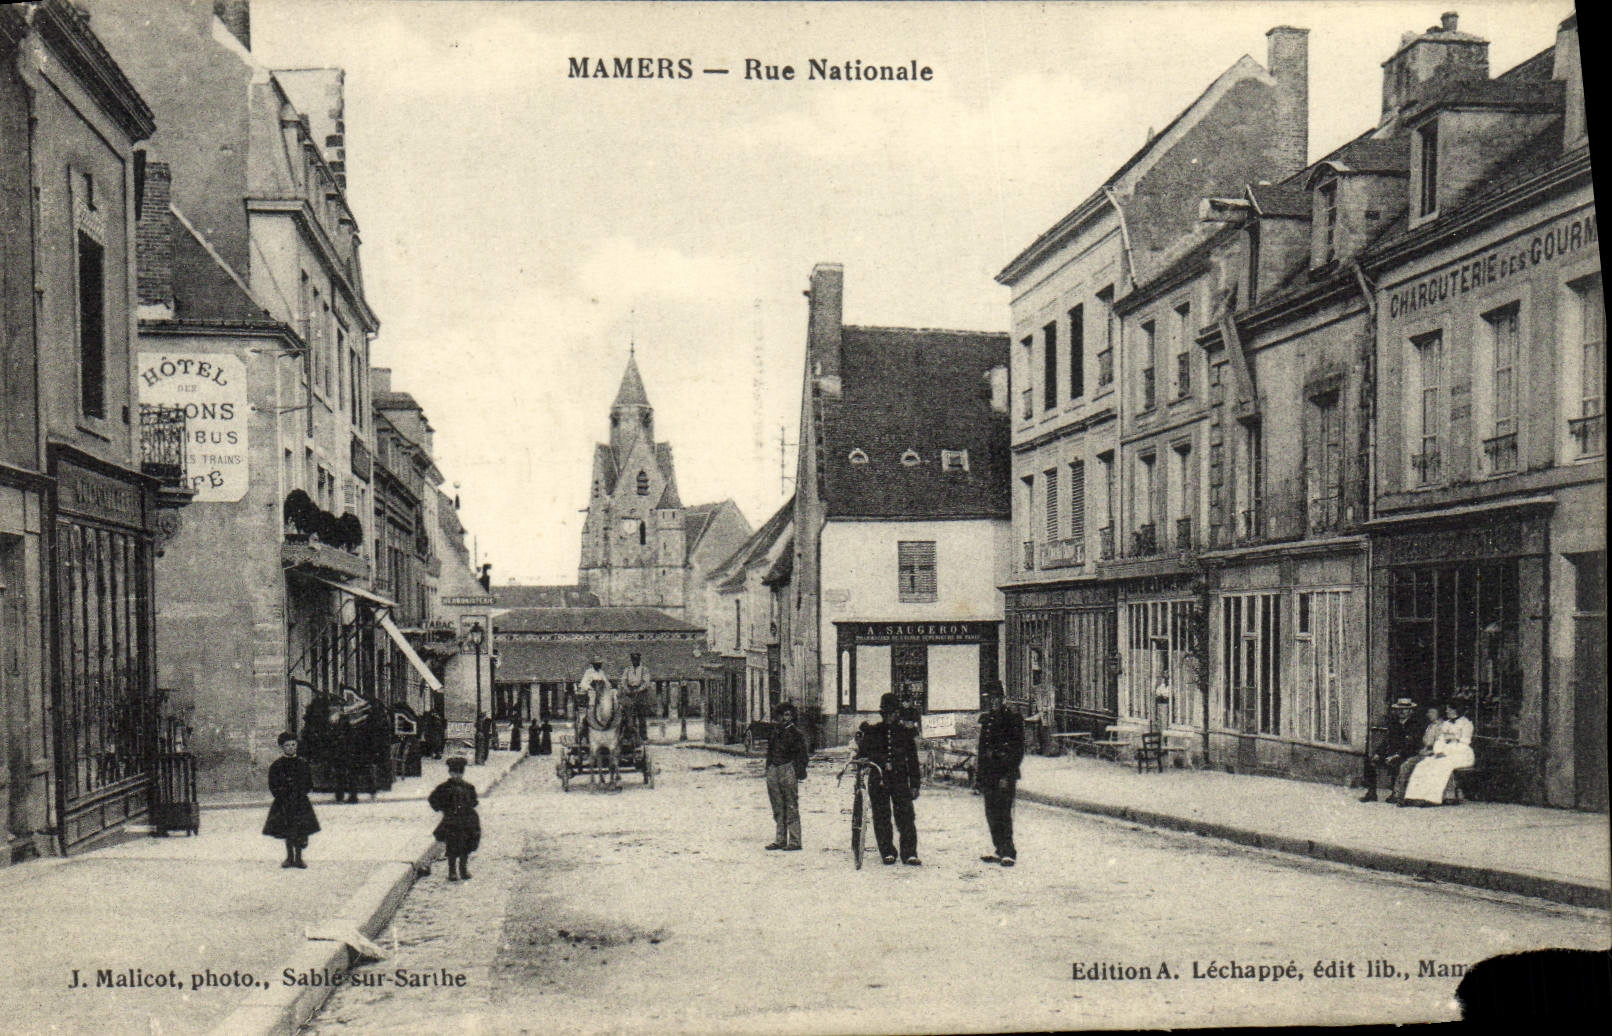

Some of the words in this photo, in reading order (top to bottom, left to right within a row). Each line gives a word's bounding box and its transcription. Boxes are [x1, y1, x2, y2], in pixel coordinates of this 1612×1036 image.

[1390, 254, 1497, 318] CHARCUTERIE
[141, 356, 228, 387] HÔTEL
[202, 454, 242, 465] TRAINS
[886, 624, 969, 635] SAUGERON
